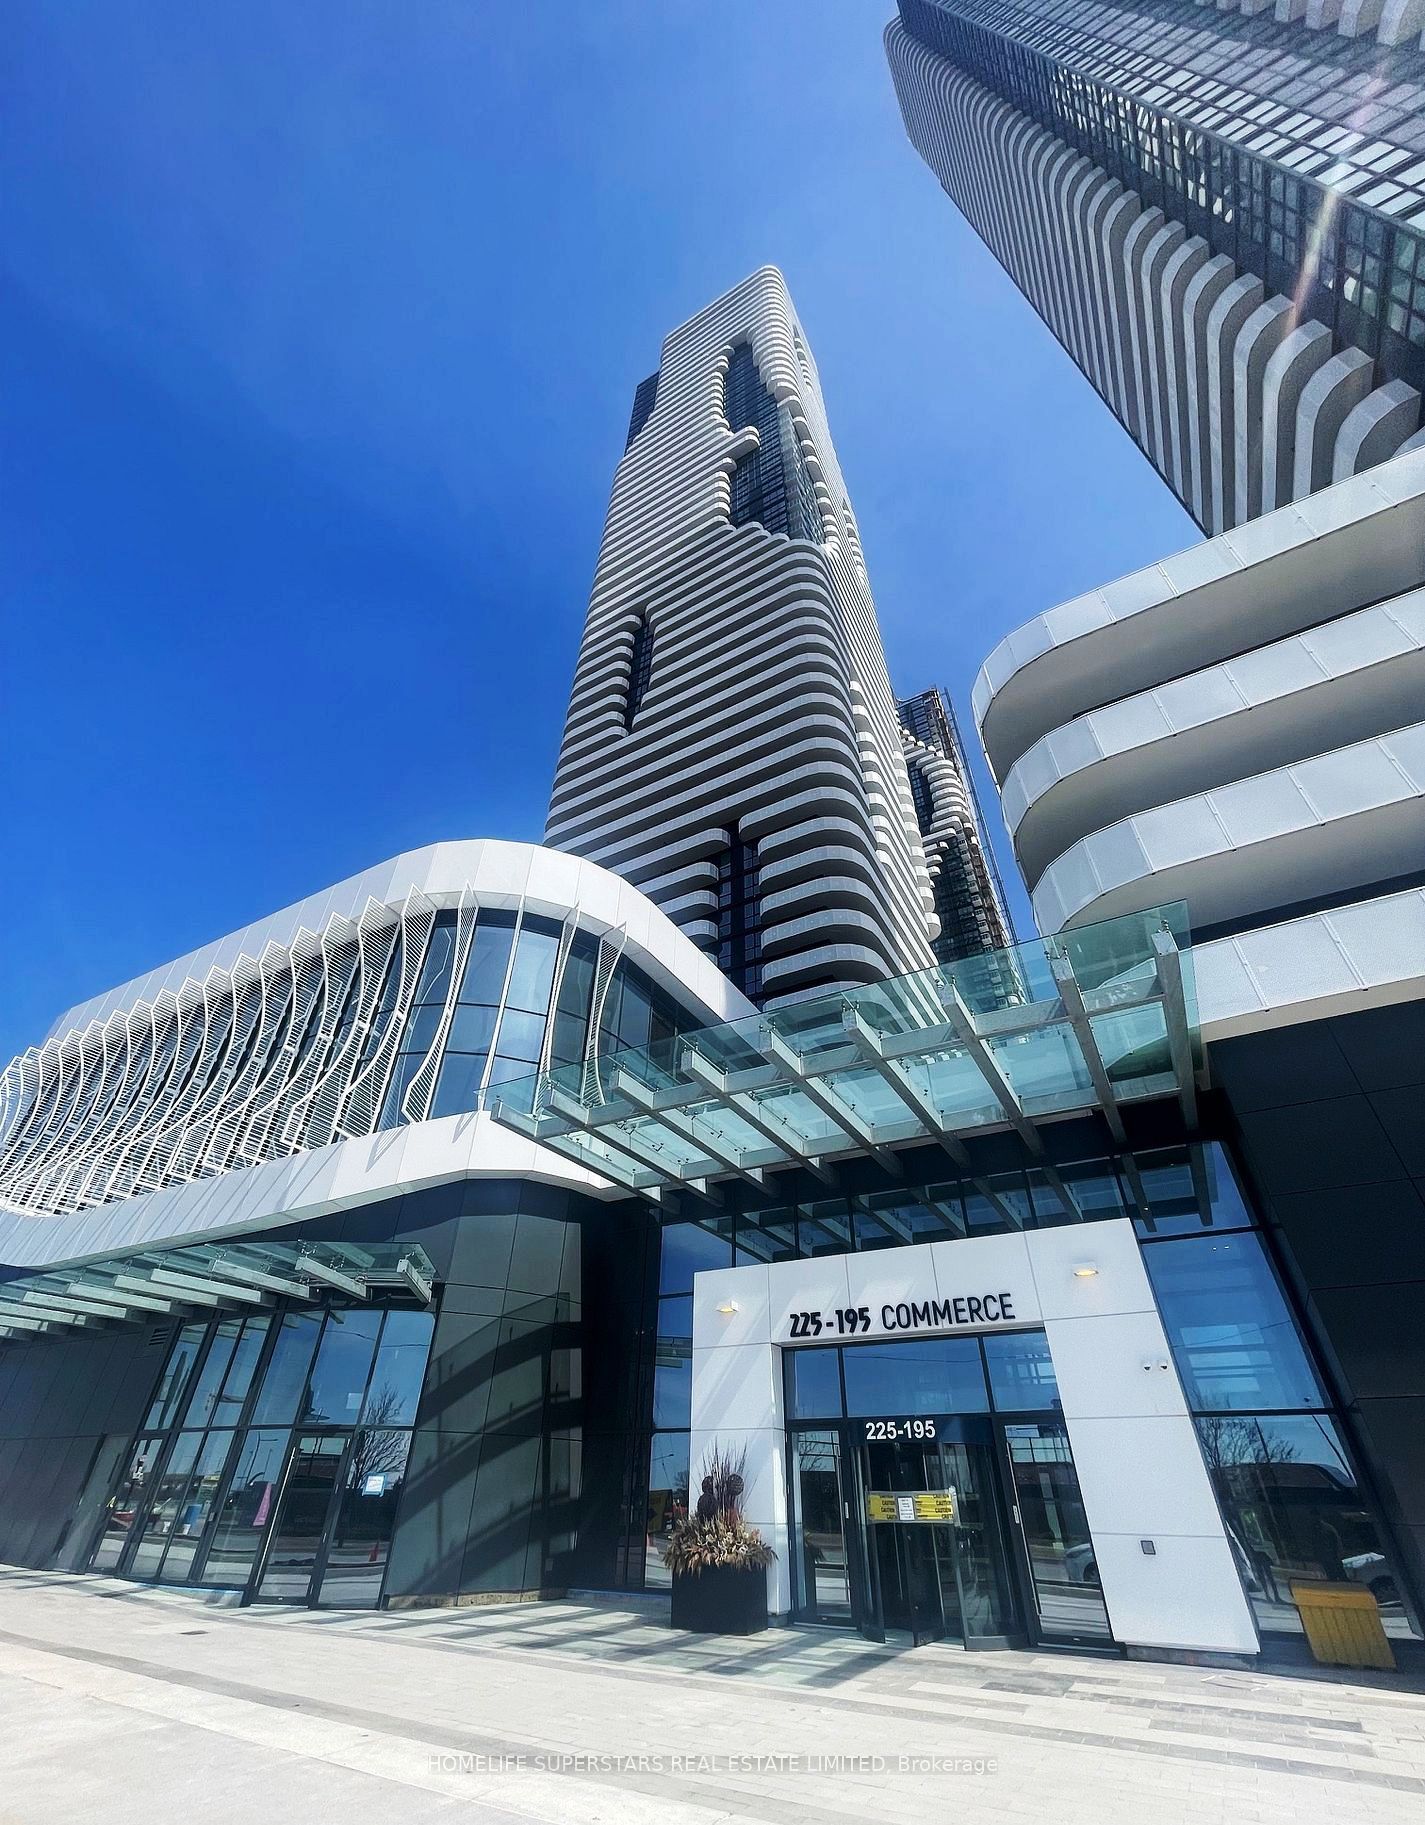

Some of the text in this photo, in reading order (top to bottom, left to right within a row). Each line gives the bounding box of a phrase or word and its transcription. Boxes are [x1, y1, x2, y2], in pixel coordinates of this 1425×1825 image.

[789, 1293, 1016, 1337] 225-195 COMMERCE
[865, 1420, 936, 1440] 225-195
